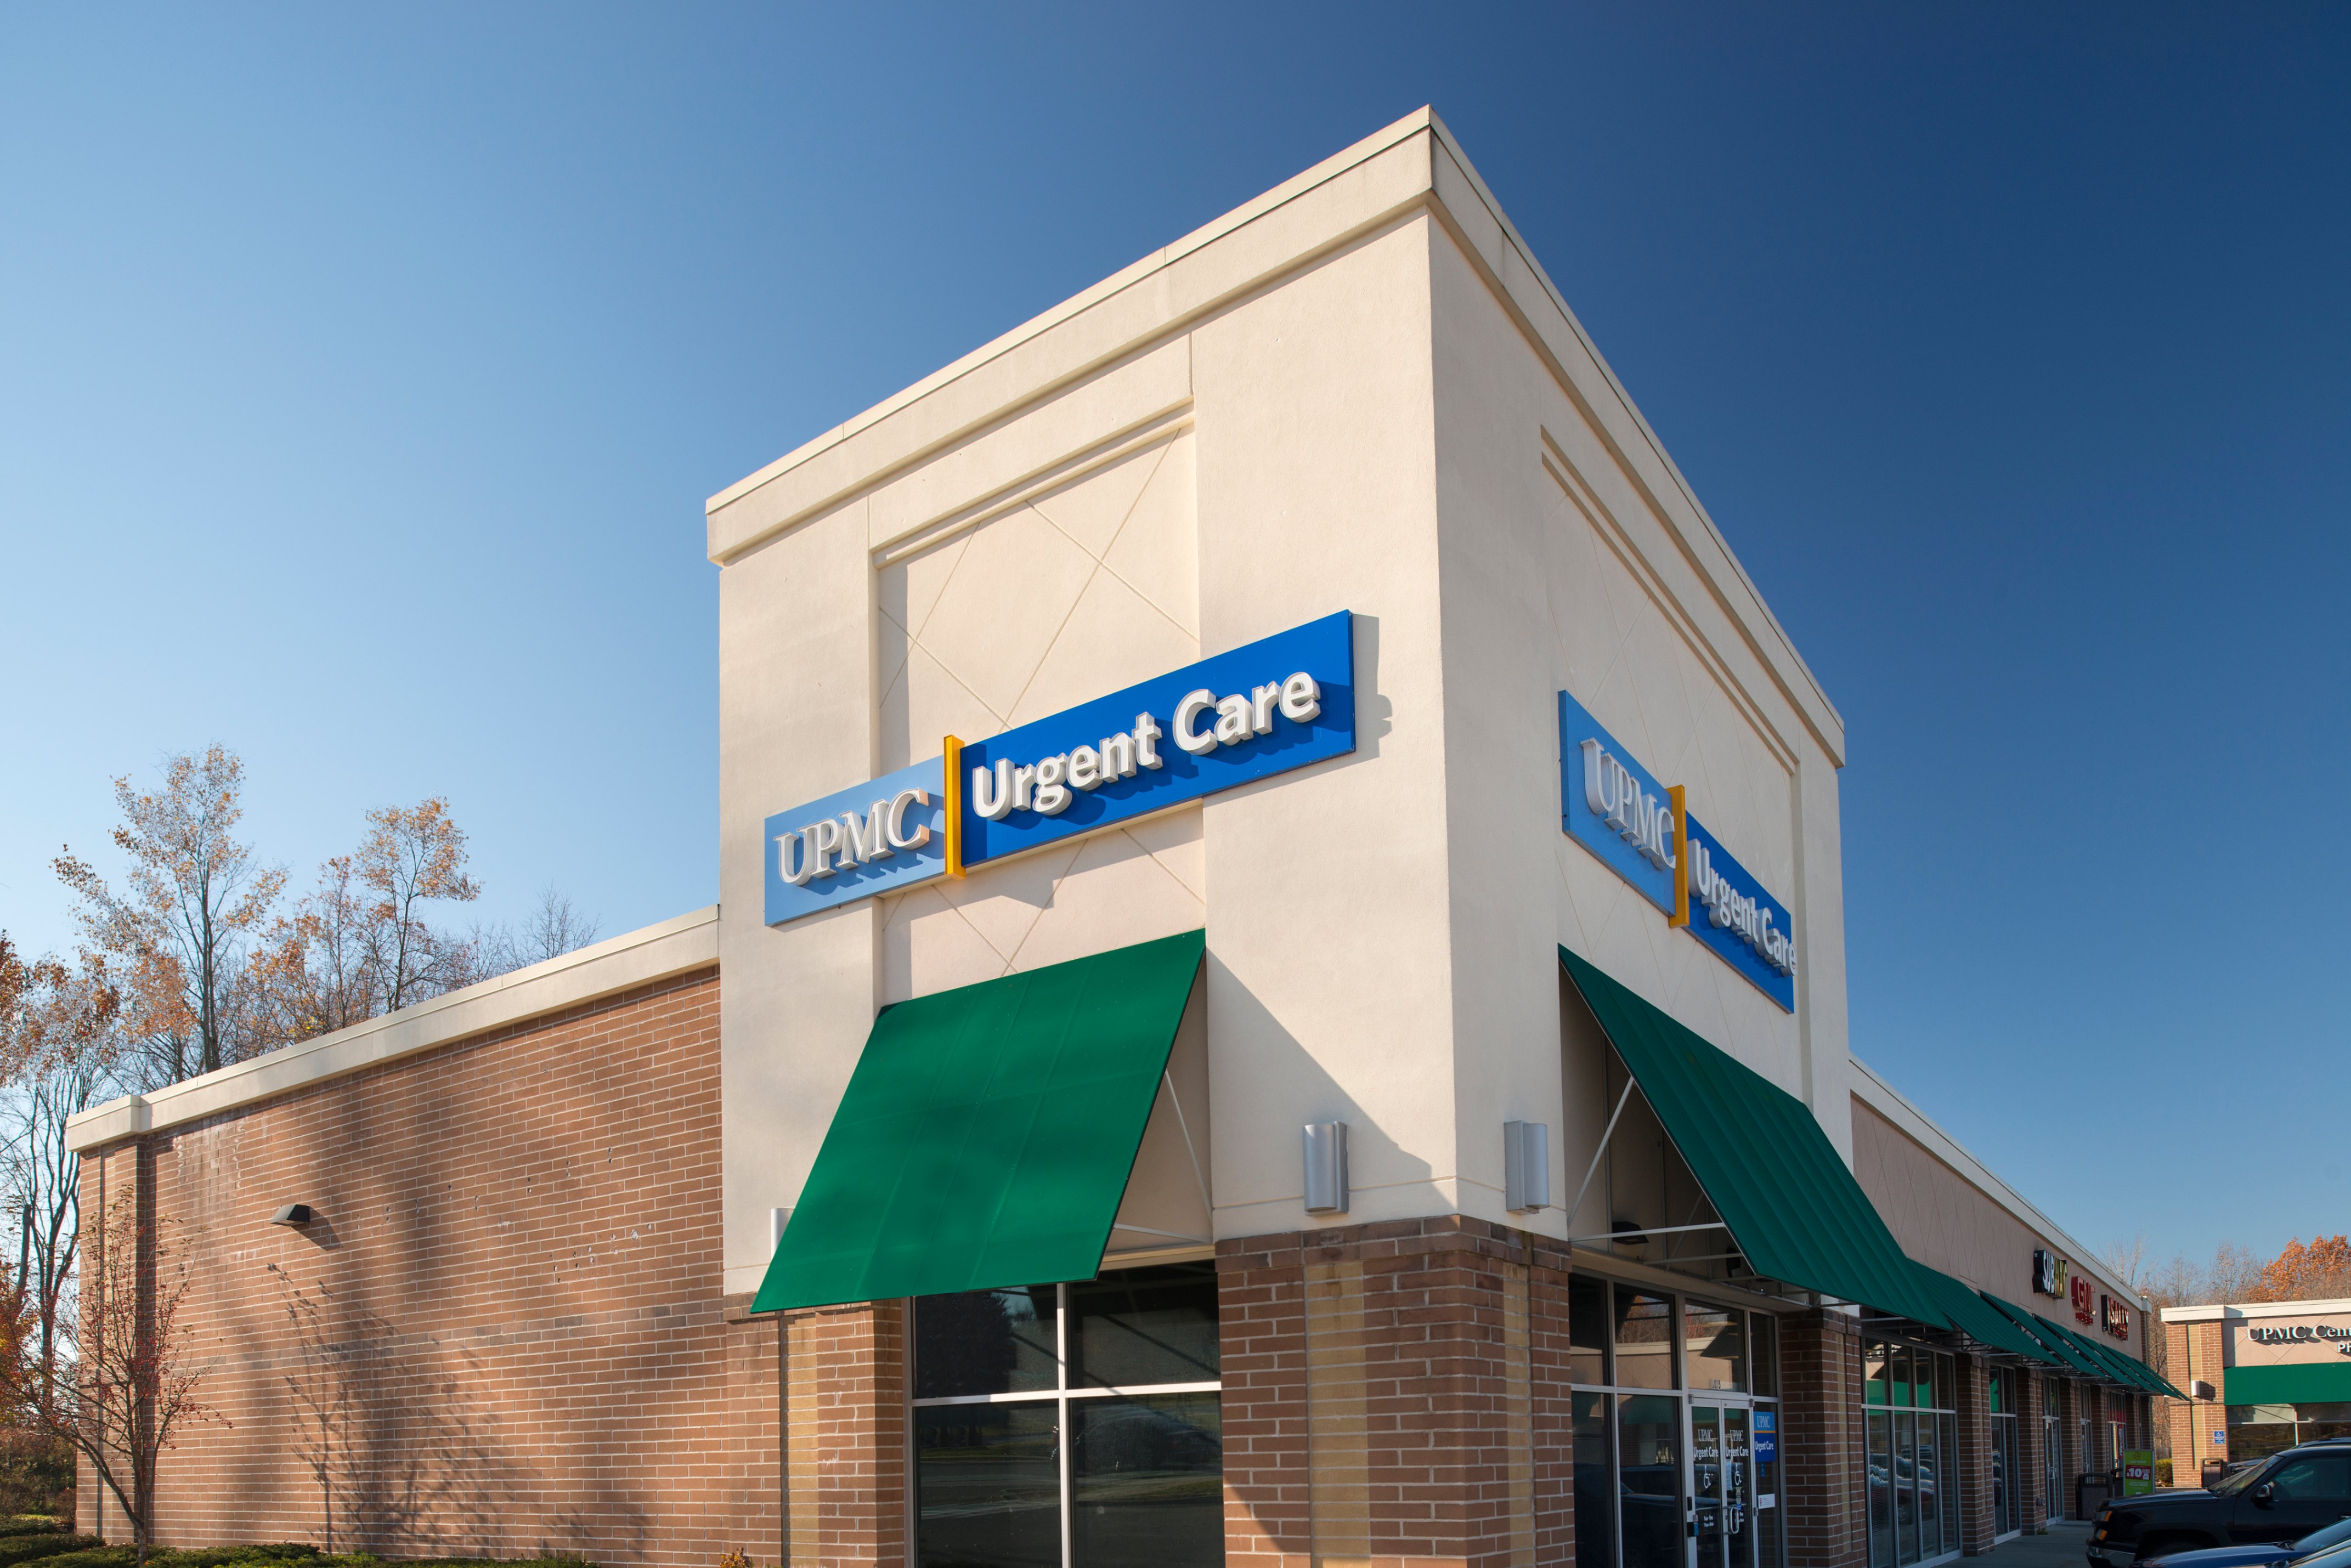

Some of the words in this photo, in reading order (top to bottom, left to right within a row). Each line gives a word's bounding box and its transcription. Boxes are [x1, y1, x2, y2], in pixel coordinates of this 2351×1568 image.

[773, 787, 930, 886] UPMC
[972, 711, 1163, 820] Urgent
[1172, 671, 1321, 756] Care
[1580, 737, 1676, 871] UPMC
[1687, 838, 1759, 944] Urgent
[1754, 907, 1796, 977] Care
[2036, 1250, 2067, 1299] SUBWAY
[2072, 1276, 2096, 1316] GNC
[2246, 1325, 2306, 1341] UPMC
[1756, 1416, 1771, 1428] UPMC
[1698, 1429, 1714, 1442] UPMC
[1730, 1429, 1744, 1442] UPMC
[1693, 1446, 1708, 1460] Urgent
[1709, 1446, 1719, 1457] Care
[1725, 1446, 1739, 1459] Urgent
[1739, 1446, 1749, 1457] Care
[1755, 1441, 1766, 1452] Urgent
[1766, 1441, 1774, 1450] Care
[2126, 1468, 2142, 1478] $10
